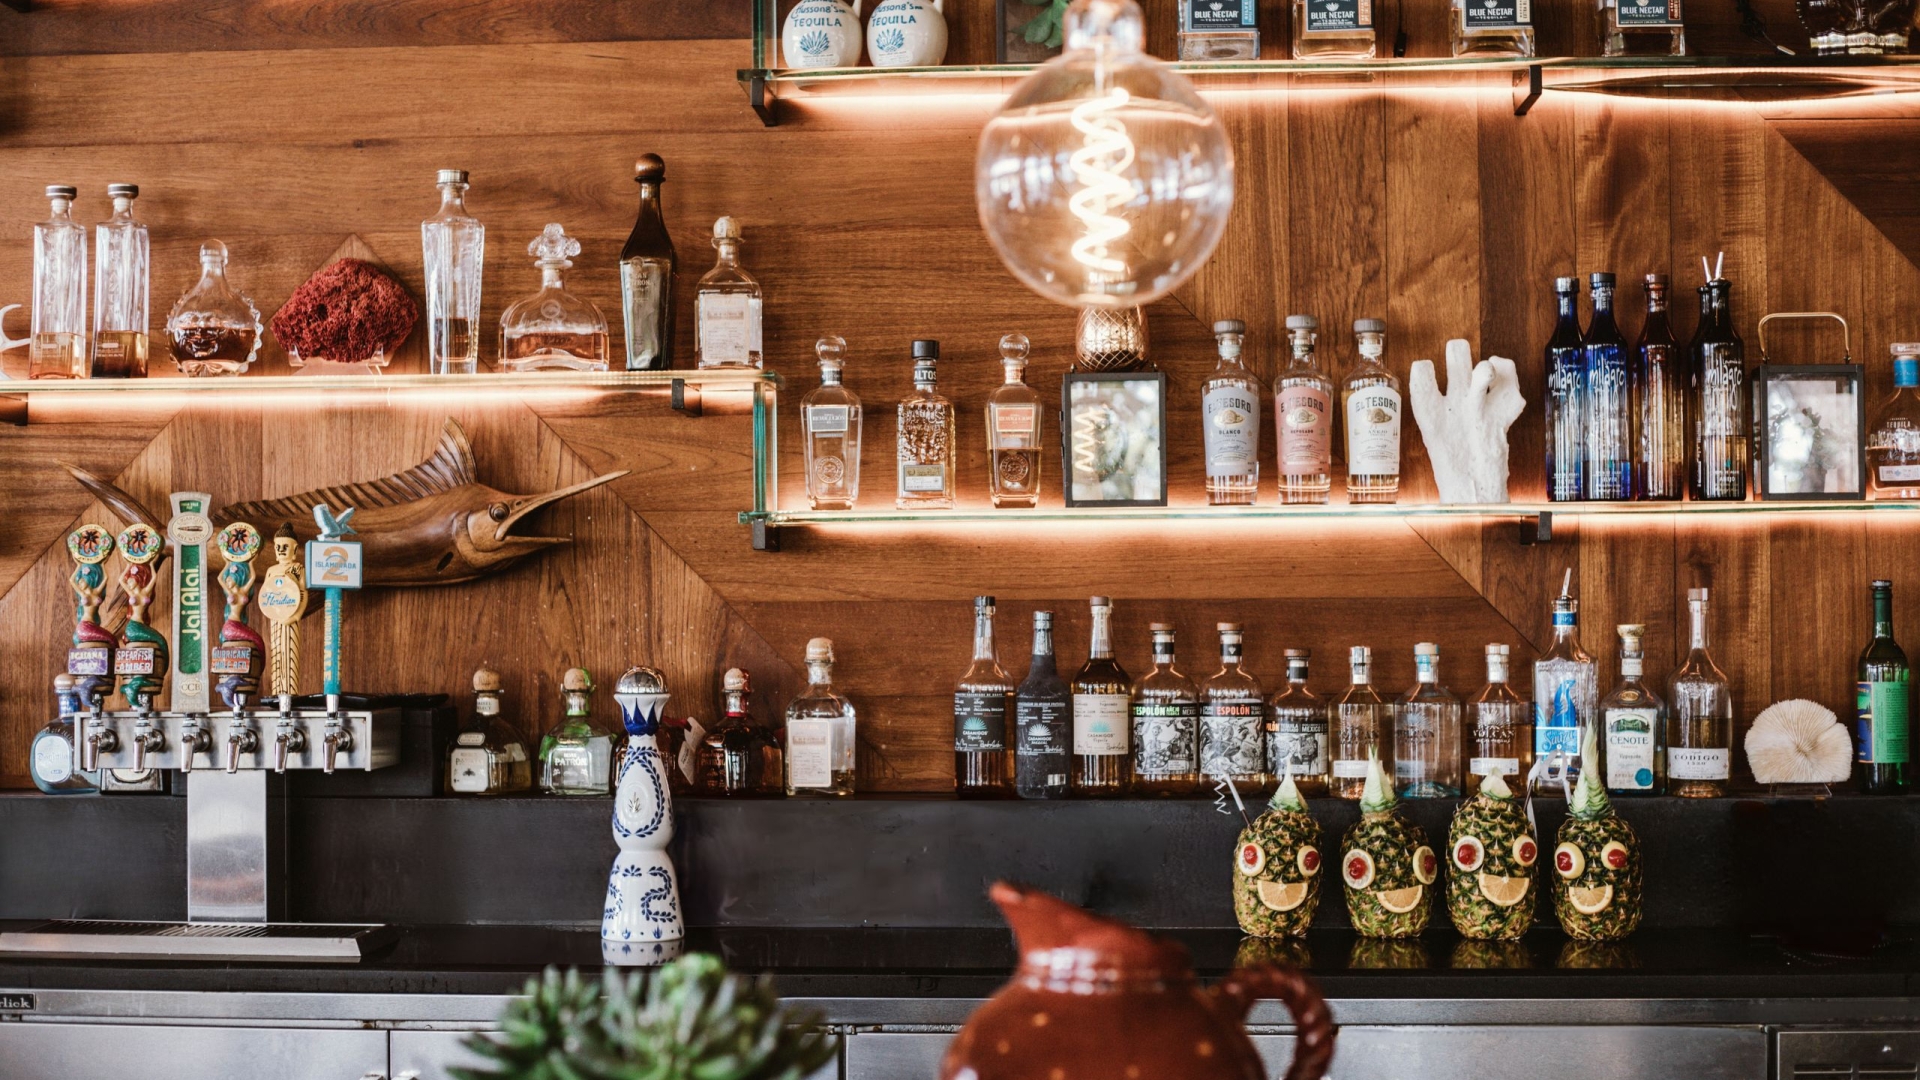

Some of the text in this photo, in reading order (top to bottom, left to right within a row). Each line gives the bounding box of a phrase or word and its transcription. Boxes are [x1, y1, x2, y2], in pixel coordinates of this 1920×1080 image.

[794, 18, 842, 27] TEQUILA
[872, 15, 916, 27] TEQUILA
[914, 370, 937, 380] ALTOS
[1590, 354, 1624, 405] milagro
[1217, 398, 1251, 414] TESORO
[1365, 396, 1397, 412] TESORO
[315, 561, 356, 569] ISLAMORADA
[262, 592, 296, 606] Floridian
[182, 609, 200, 641] Jai
[70, 651, 103, 660] IGUANA
[116, 650, 154, 660] SPEARFISH
[214, 650, 250, 659] HURRICANE
[120, 663, 150, 671] AMBER
[1610, 736, 1648, 745] CENOTE
[555, 757, 587, 766] PATRÓN
